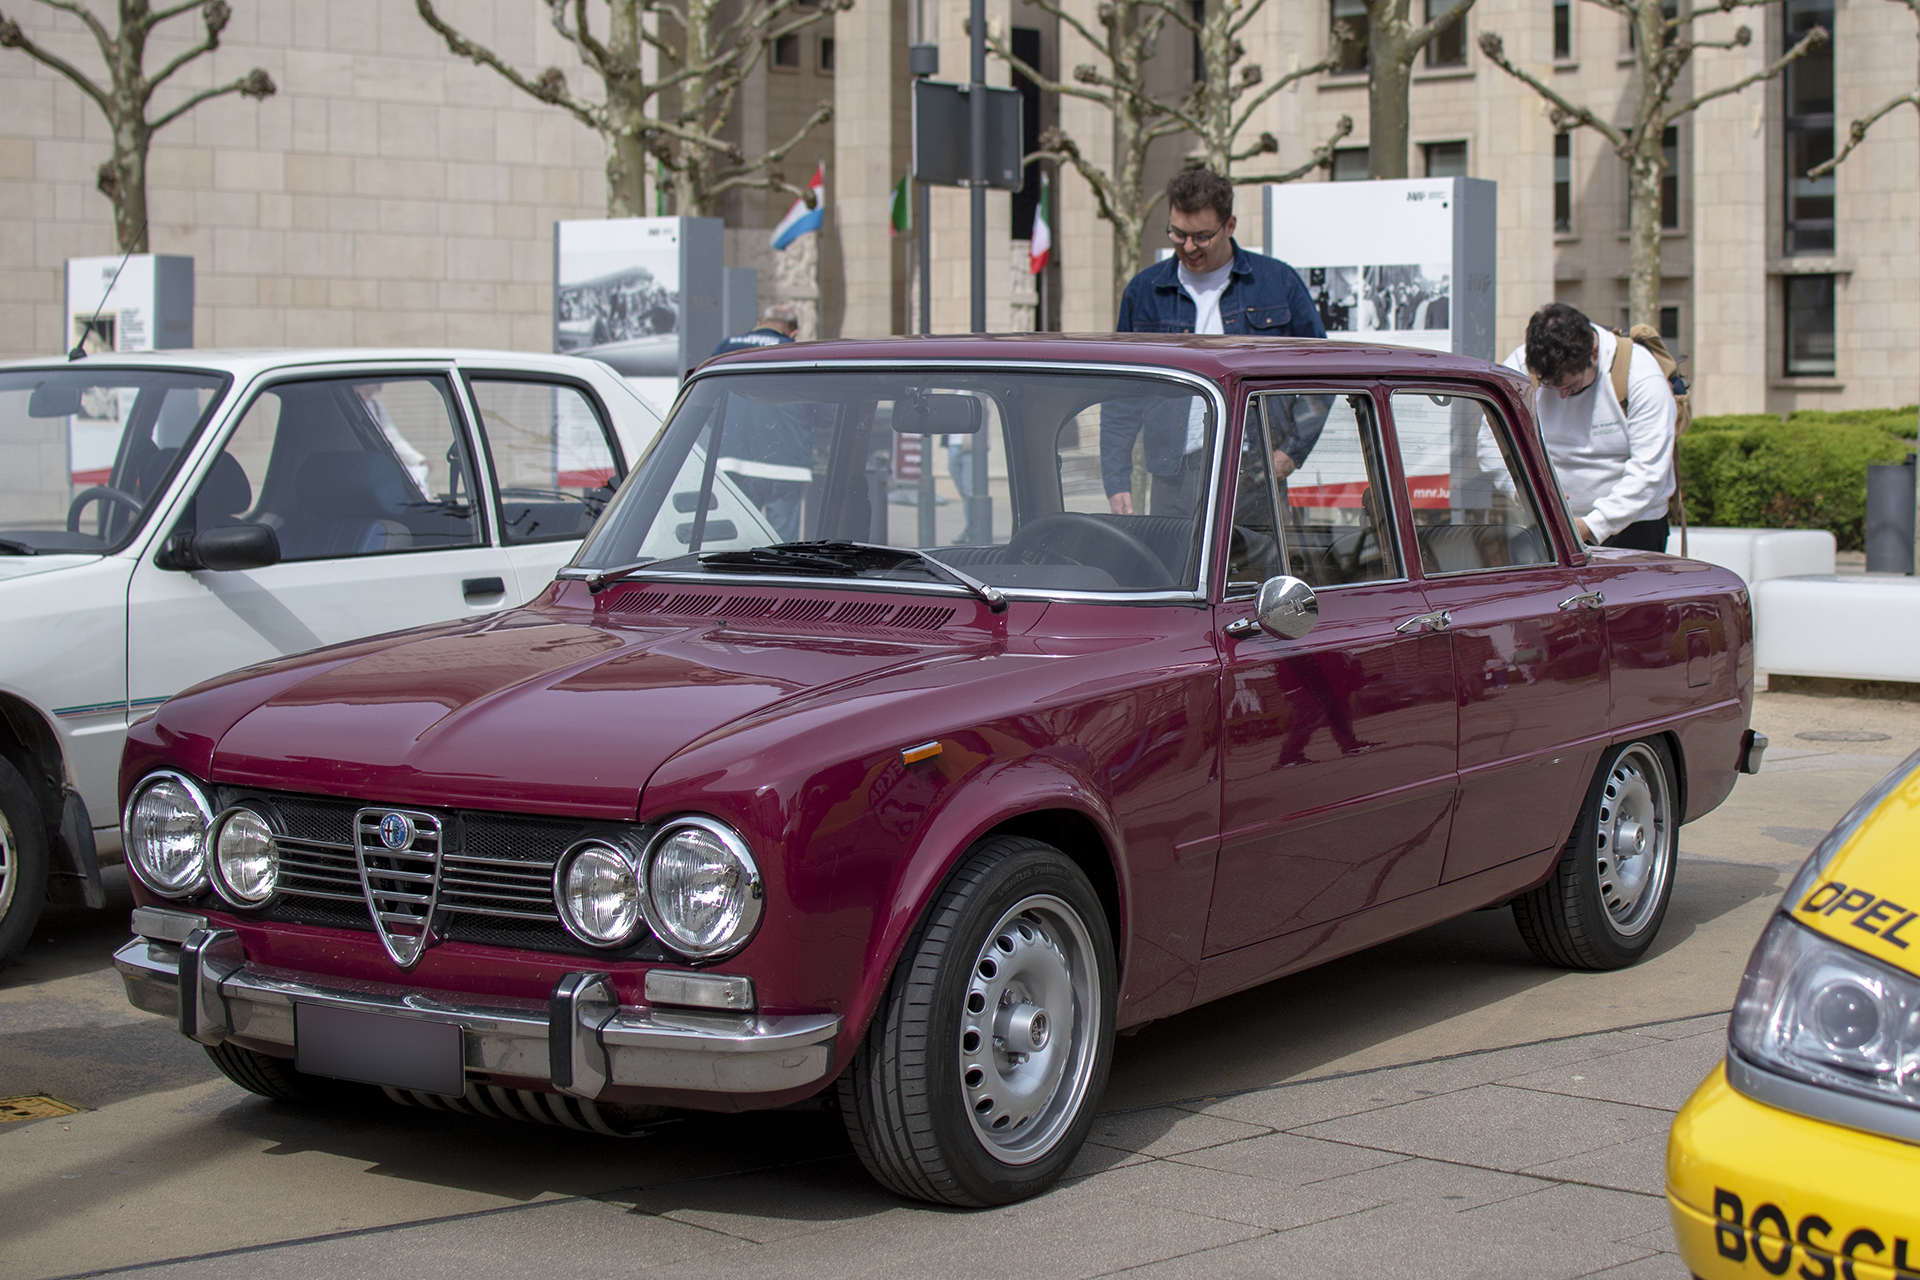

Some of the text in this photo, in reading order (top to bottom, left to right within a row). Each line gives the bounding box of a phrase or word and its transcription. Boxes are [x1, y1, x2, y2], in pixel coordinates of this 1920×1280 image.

[1413, 488, 1450, 499] mnr.lu
[391, 816, 405, 831] ROMEO
[1801, 881, 1919, 950] OPEL
